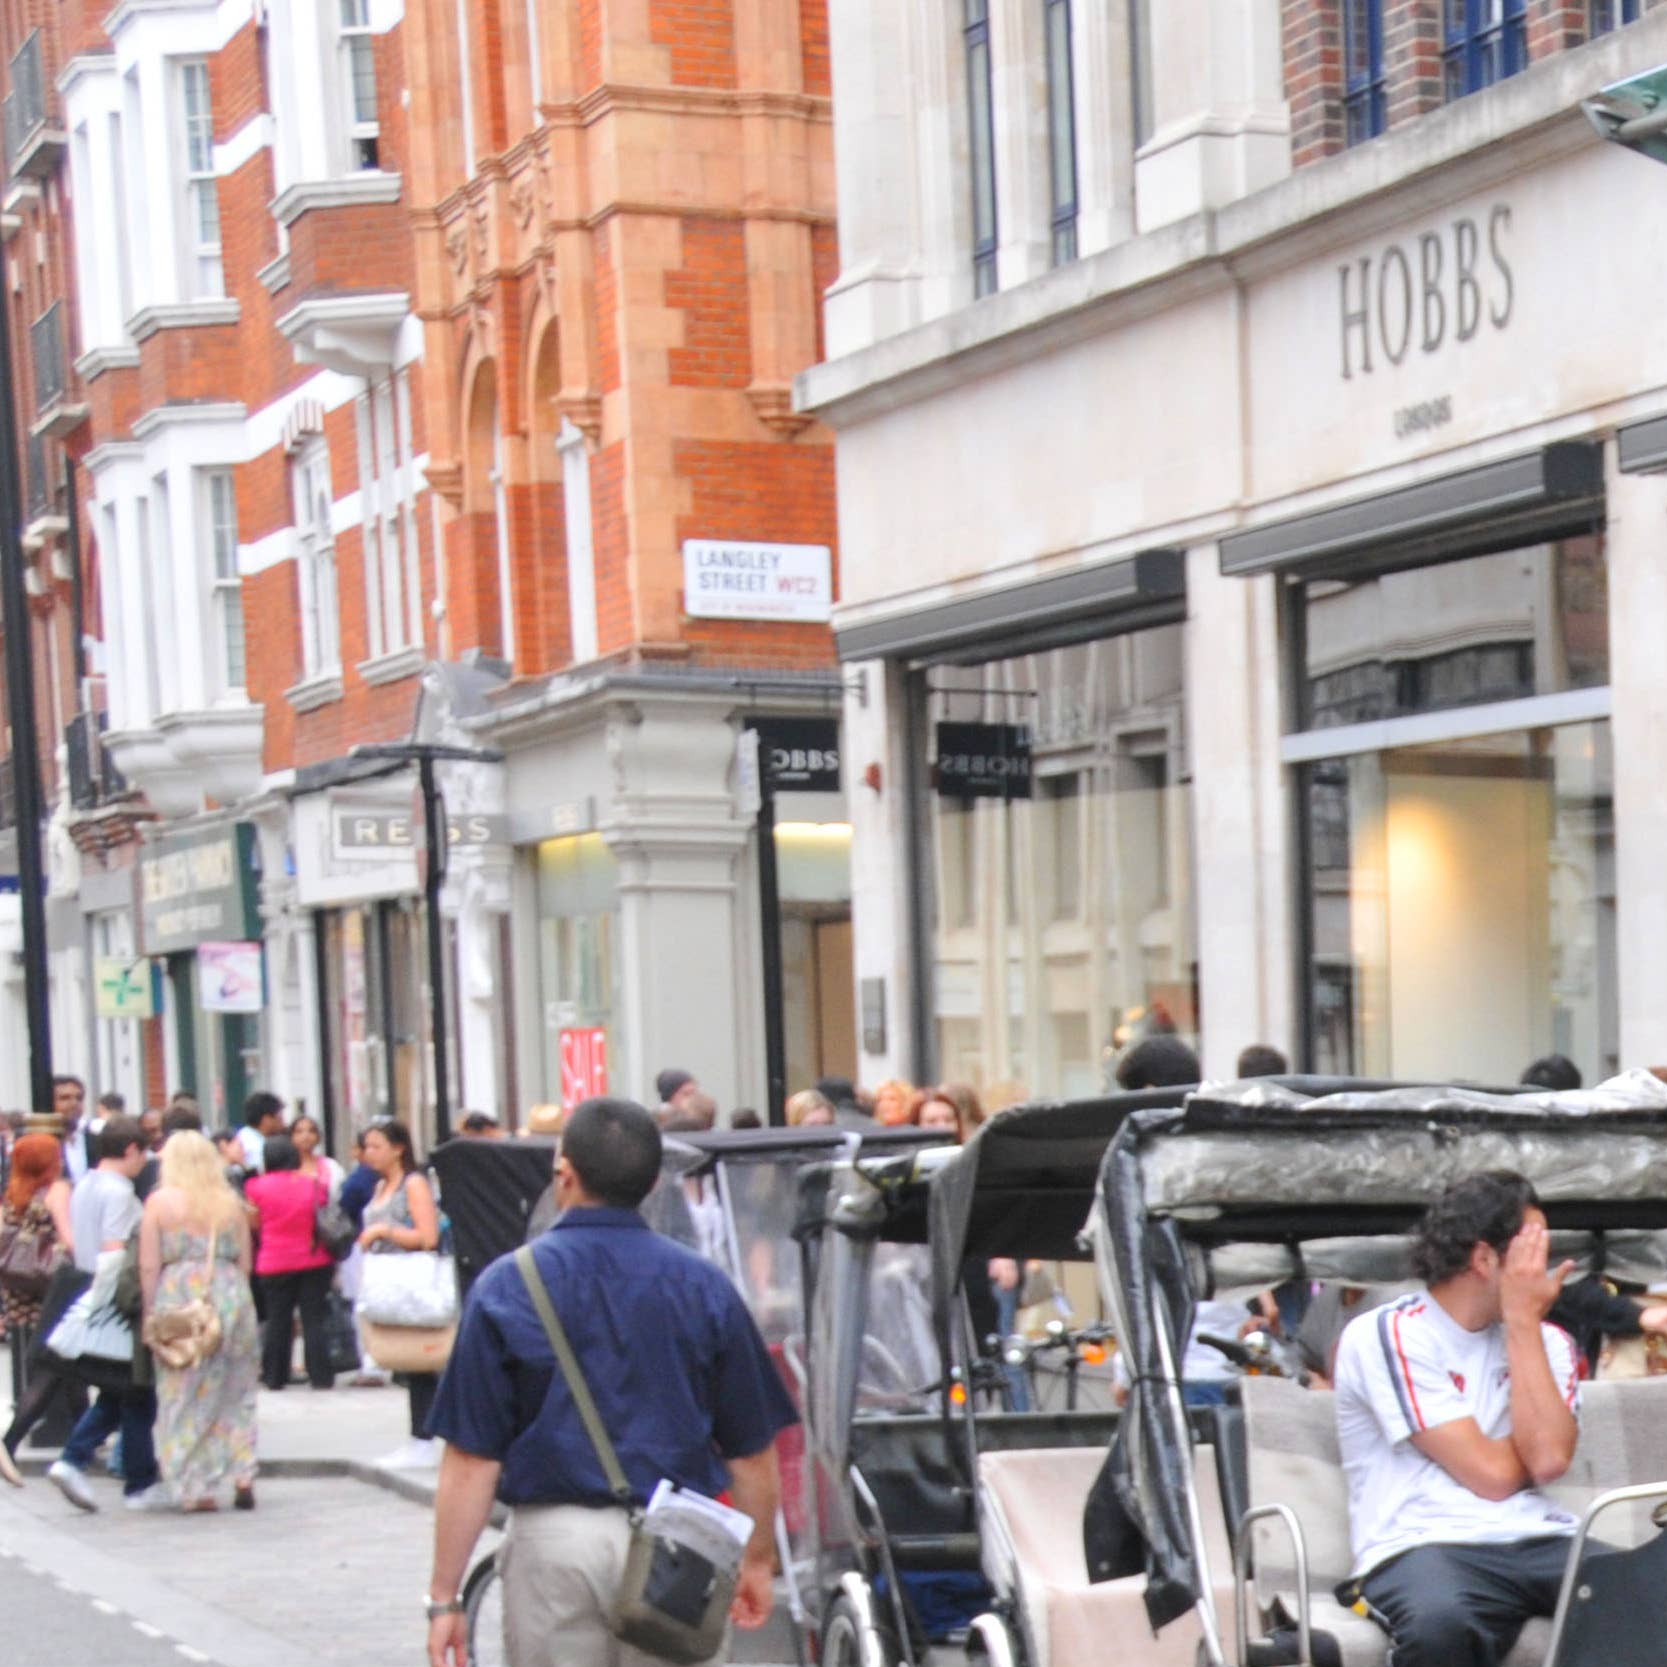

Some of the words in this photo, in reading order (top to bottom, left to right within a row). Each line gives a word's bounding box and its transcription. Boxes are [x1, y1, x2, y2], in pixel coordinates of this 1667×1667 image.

[1338, 202, 1513, 380] HOBBS
[697, 550, 782, 569] LANGLEY
[699, 571, 767, 592] STREET
[776, 575, 817, 594] WC2
[771, 748, 839, 771] OBBS
[354, 816, 491, 848] RESS
